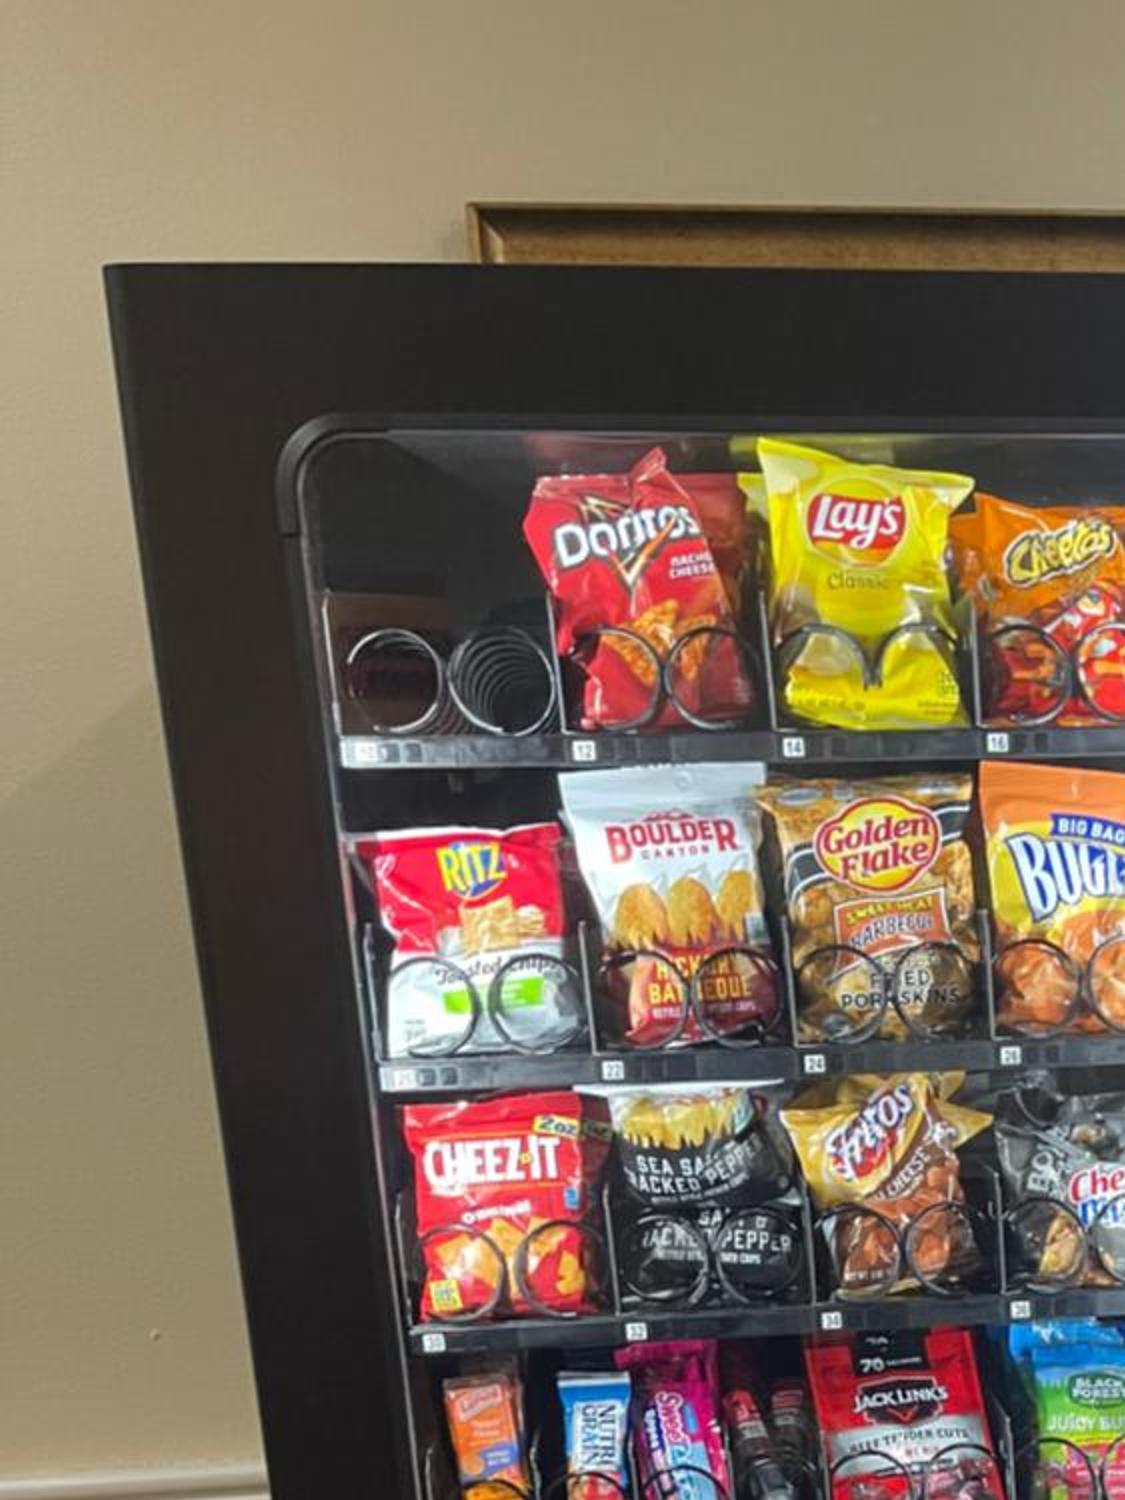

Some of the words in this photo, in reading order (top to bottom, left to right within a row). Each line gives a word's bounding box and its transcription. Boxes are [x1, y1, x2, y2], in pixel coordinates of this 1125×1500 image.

[554, 504, 702, 567] Doritos
[811, 495, 902, 549] Lay's
[1008, 520, 1116, 585] Cheetos
[605, 813, 739, 865] BOULDER
[822, 814, 931, 857] Golden
[1058, 818, 1088, 836] BIG
[434, 841, 508, 898] RITZ
[641, 844, 711, 862] CANYON
[841, 839, 930, 881] Flake
[636, 1153, 674, 1177] SEA
[852, 1390, 898, 1414] JACK
